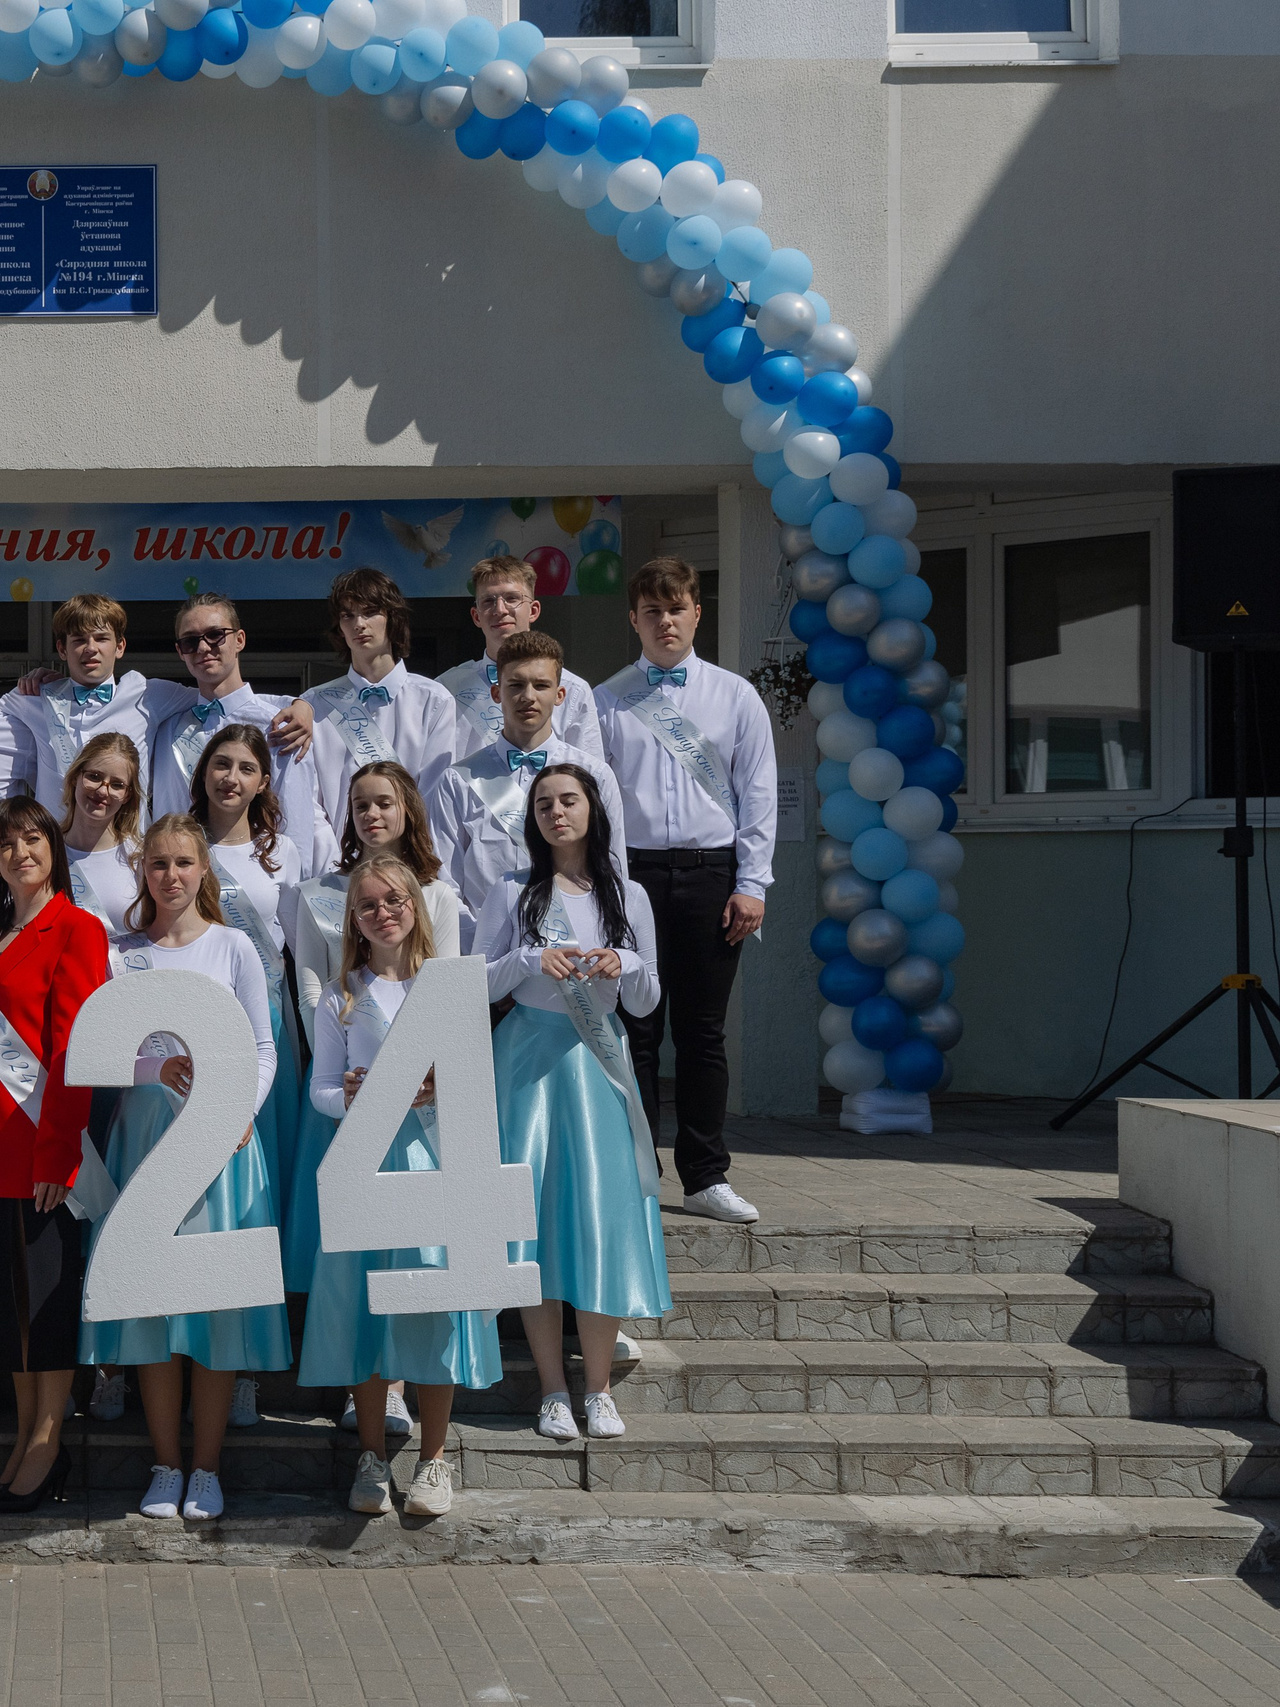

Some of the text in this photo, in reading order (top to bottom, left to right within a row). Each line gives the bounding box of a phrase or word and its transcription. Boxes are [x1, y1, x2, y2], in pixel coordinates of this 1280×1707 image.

[72, 219, 129, 229] Дзяржаўная
[80, 231, 121, 240] ўстанова
[80, 243, 122, 253] адукацыі
[55, 259, 147, 270] «Сярэдняя школа
[59, 271, 93, 281] №194
[132, 511, 352, 561] школа!
[652, 706, 718, 782] Выпускник
[585, 1017, 619, 1060] 2024
